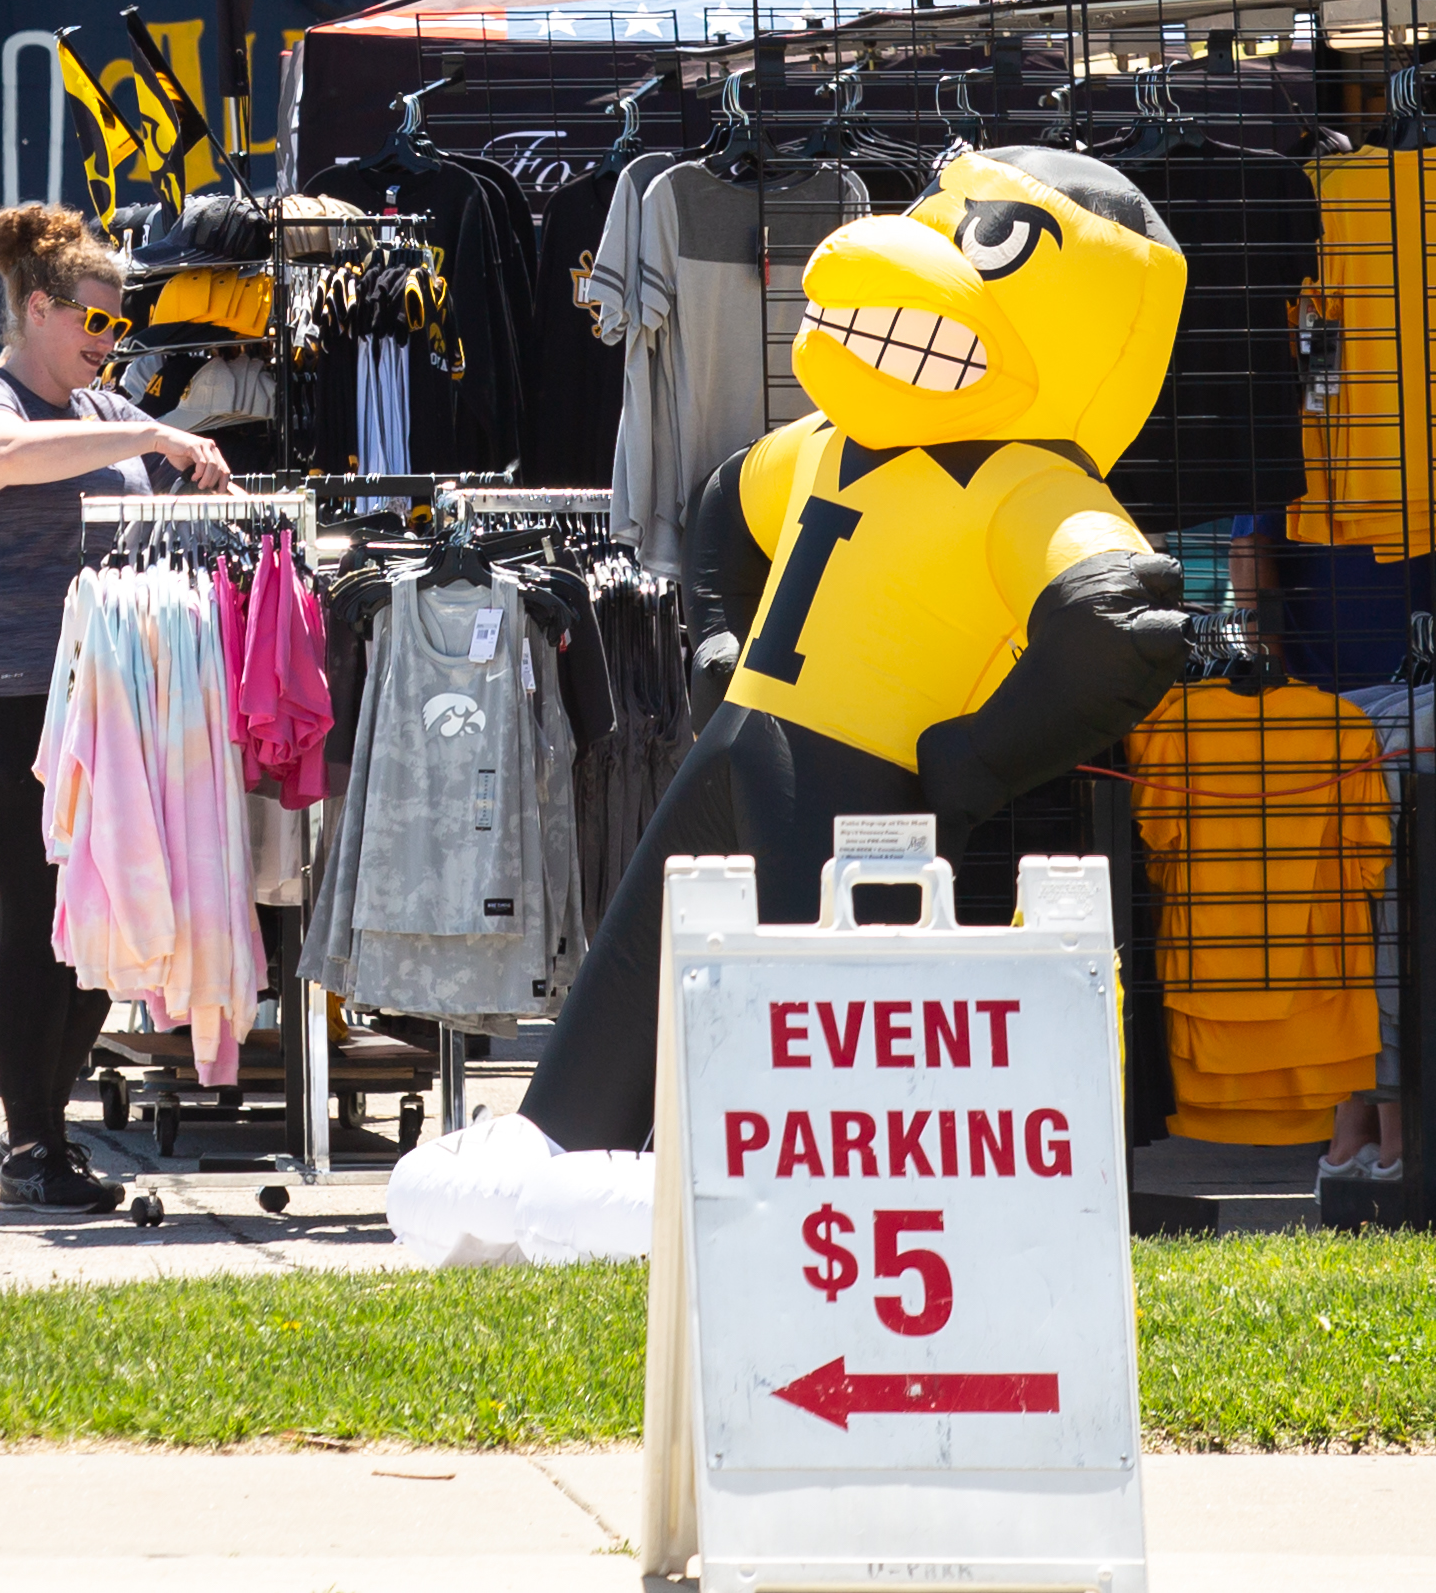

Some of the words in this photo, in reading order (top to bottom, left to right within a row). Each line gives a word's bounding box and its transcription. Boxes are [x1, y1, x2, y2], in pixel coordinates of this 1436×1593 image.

[768, 999, 1021, 1069] EVENT
[724, 1107, 1072, 1179] PARKING
[802, 1202, 954, 1337] $5
